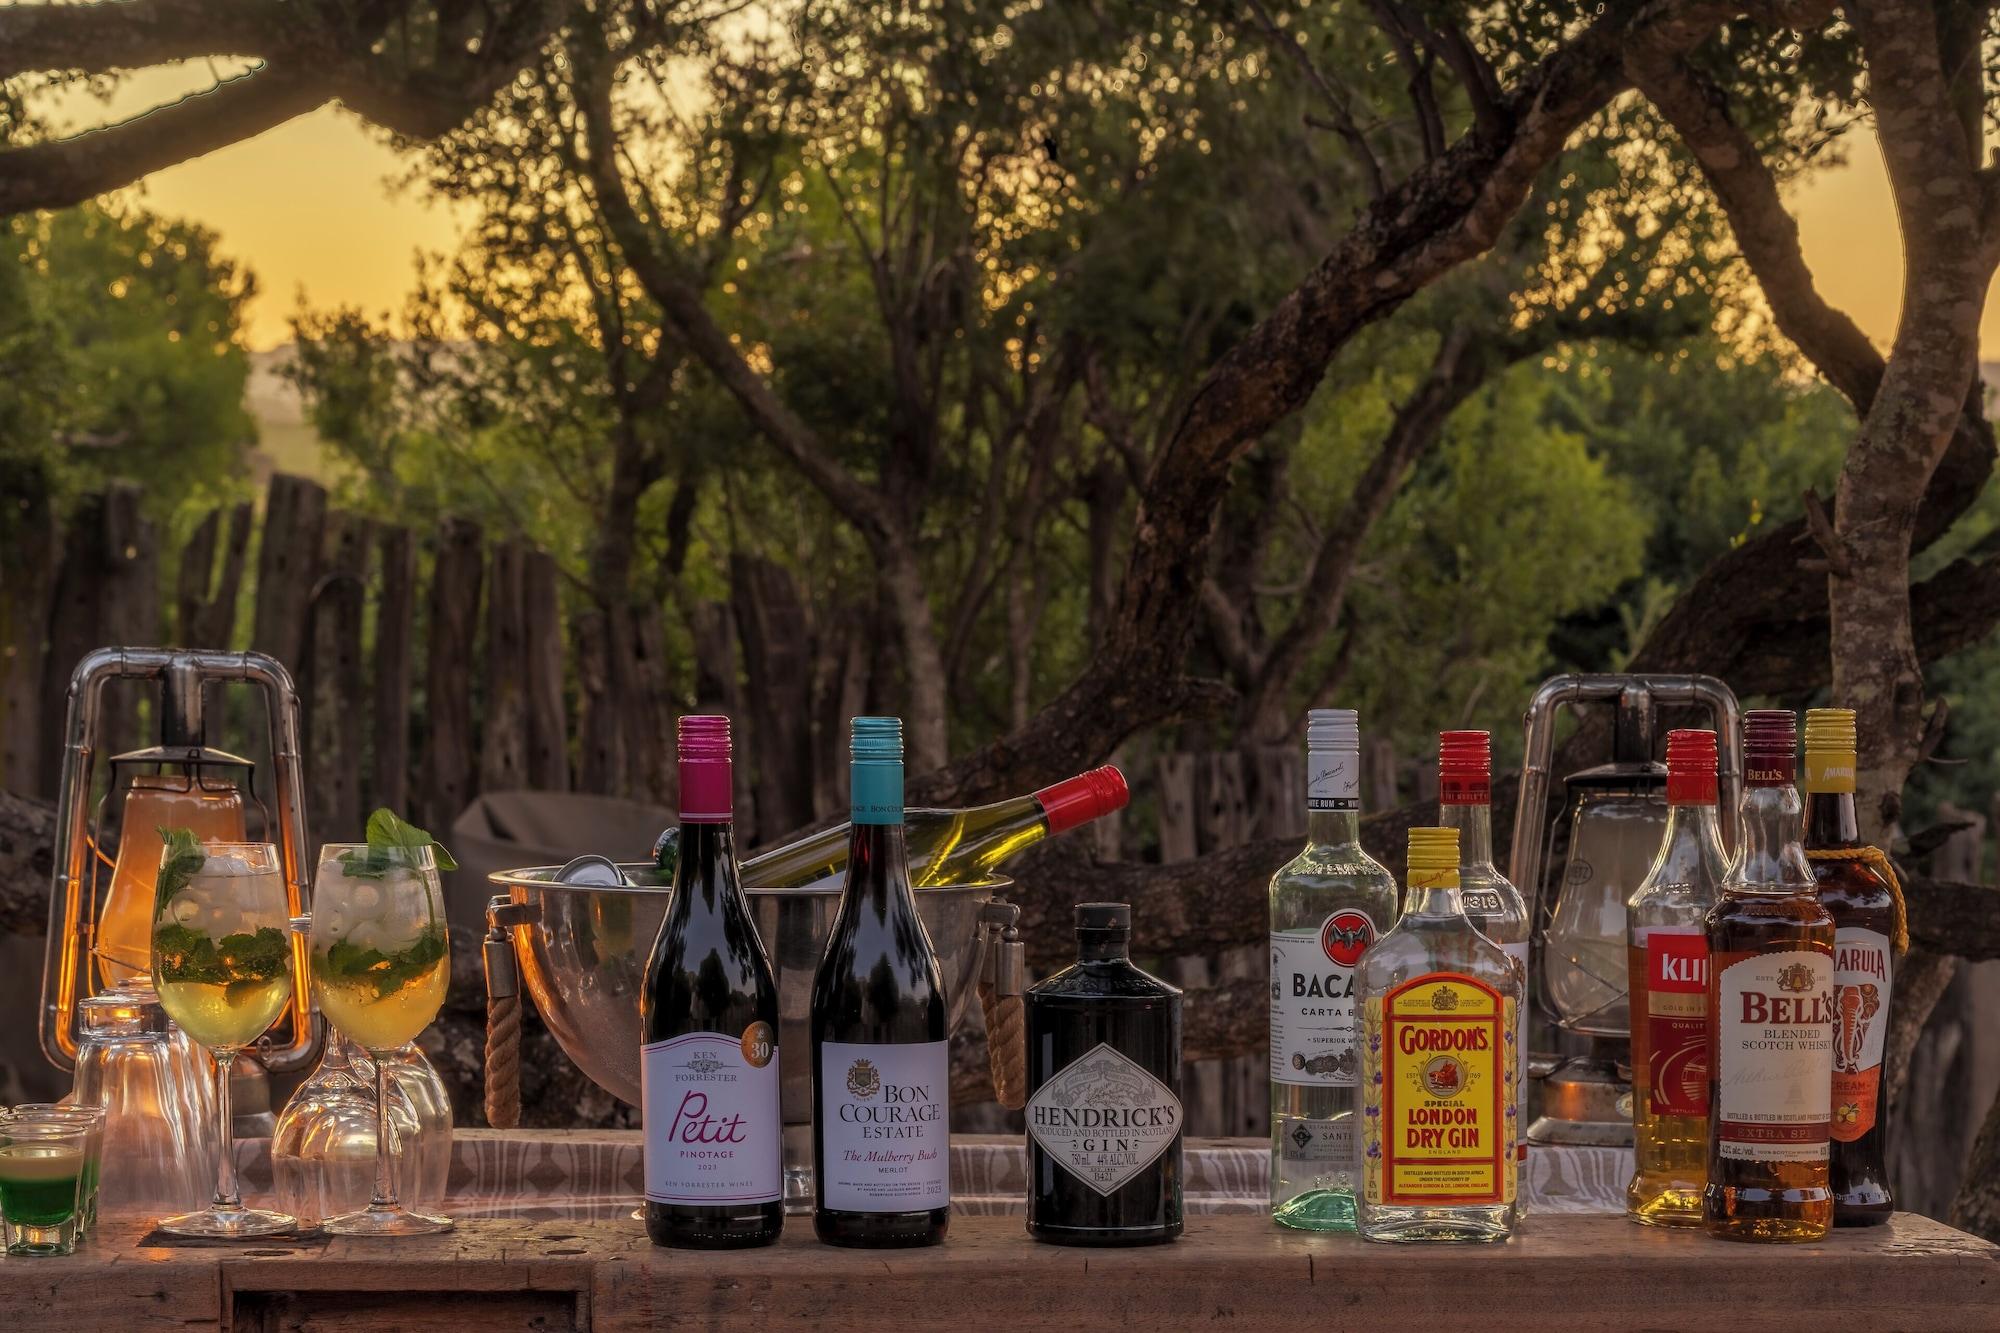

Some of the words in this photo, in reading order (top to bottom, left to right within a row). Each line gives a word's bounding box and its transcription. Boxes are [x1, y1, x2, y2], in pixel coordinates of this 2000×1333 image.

[1301, 1008, 1342, 1016] CARTA
[1740, 990, 1832, 1024] BELL'S
[1400, 1025, 1488, 1055] GORDON'S
[1764, 1029, 1820, 1038] BLENDED
[752, 1042, 769, 1059] 30
[1742, 1041, 1794, 1050] SCOTCH
[675, 1074, 737, 1082] FORRESTER
[883, 1085, 929, 1103] BON
[668, 1090, 747, 1144] Petit
[840, 1103, 941, 1123] COURAGE
[1034, 1105, 1175, 1128] HENDRICK'S
[1408, 1108, 1478, 1125] LONDON
[1727, 1112, 1748, 1120] DISTILLED
[1754, 1113, 1775, 1121] BOTTLED
[863, 1125, 924, 1138] ESTATE
[1037, 1126, 1072, 1137] PRODUCED
[1074, 1129, 1091, 1137] AND
[1092, 1128, 1130, 1138] BOTTLED
[1131, 1128, 1140, 1137] IN
[1142, 1126, 1174, 1137] SCOTLAND
[1407, 1127, 1446, 1148] DRY
[1448, 1127, 1480, 1148] GIN
[1738, 1128, 1785, 1138] EXTRA
[1083, 1139, 1129, 1151] GIN
[843, 1149, 861, 1160] The
[864, 1149, 914, 1164] Mulberry
[918, 1147, 938, 1161] Bush
